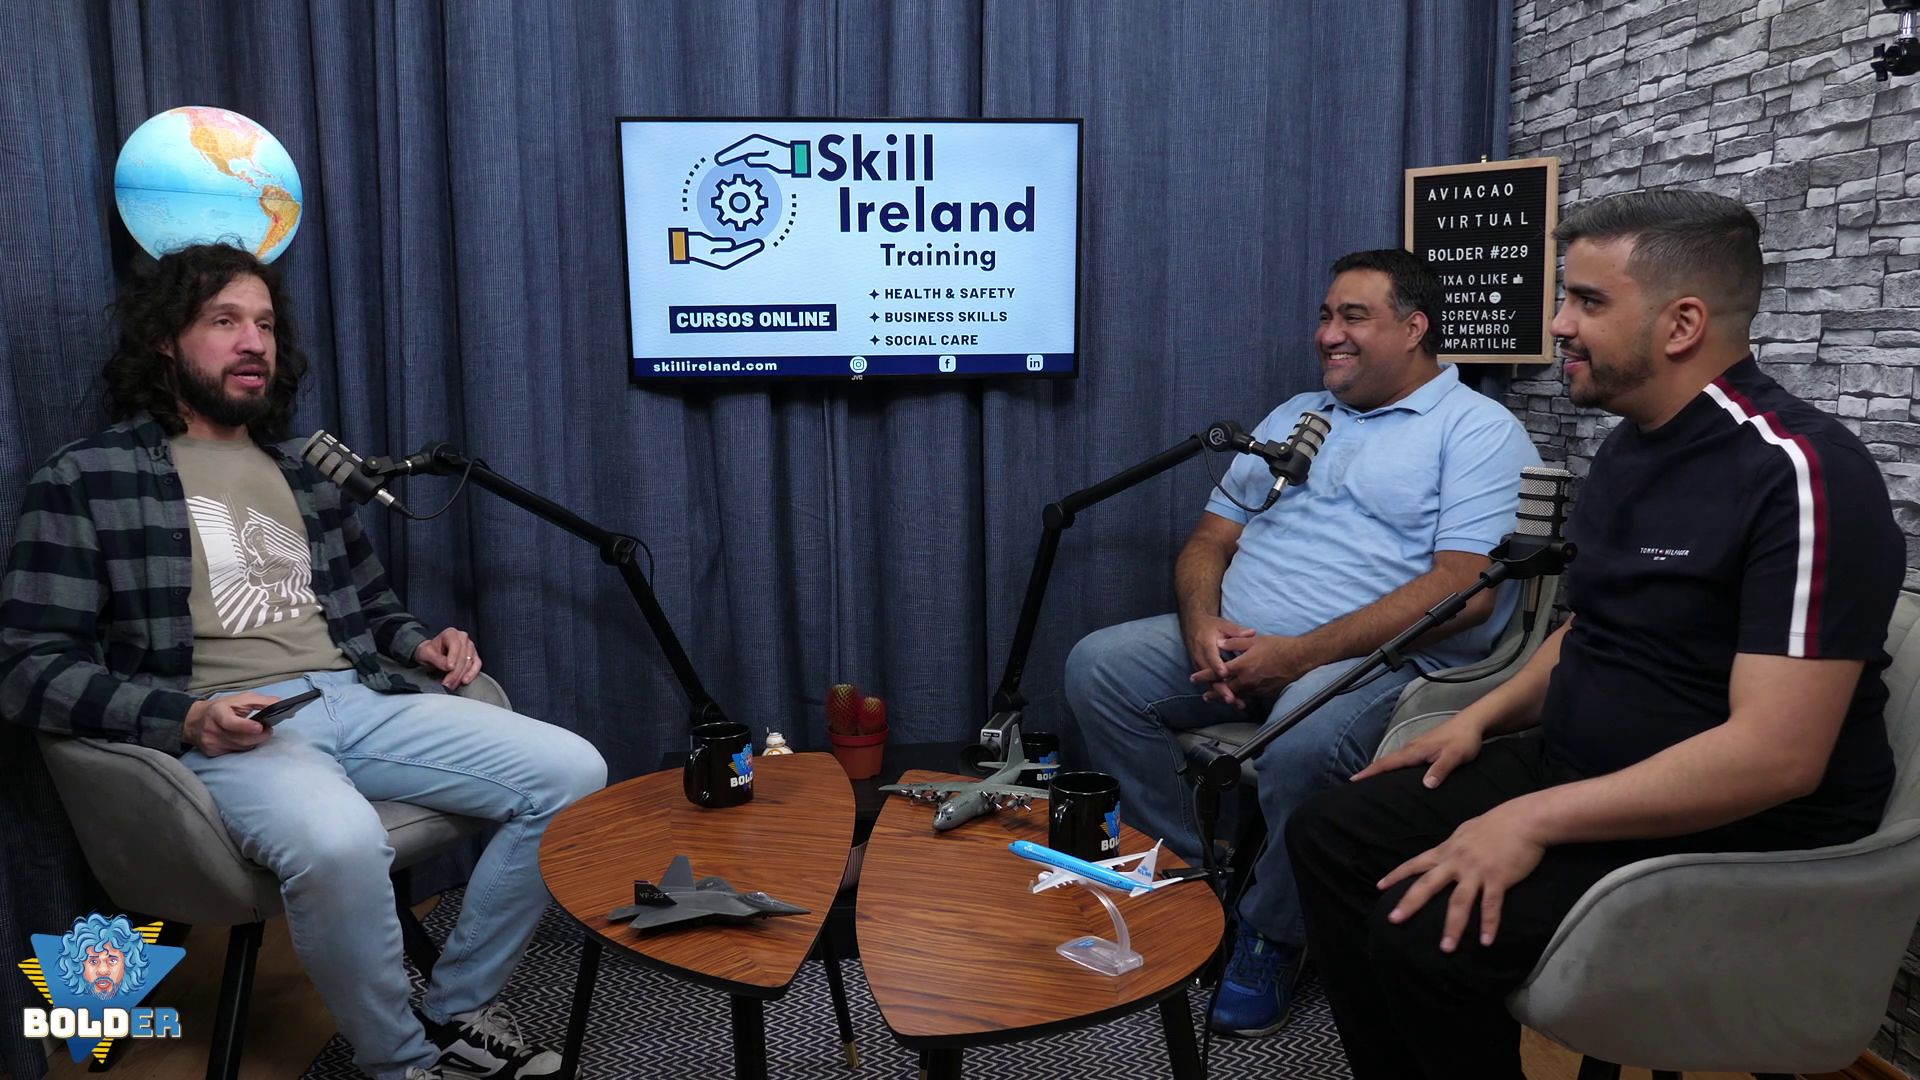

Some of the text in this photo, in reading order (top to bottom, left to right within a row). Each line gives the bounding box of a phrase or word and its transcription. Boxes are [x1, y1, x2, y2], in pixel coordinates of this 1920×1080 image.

[817, 133, 934, 182] Skill
[1427, 183, 1514, 201] AVIACAO
[839, 185, 1036, 233] Ireland
[1437, 211, 1529, 230] VIRTUAL
[879, 242, 997, 271] Training
[1427, 244, 1529, 262] BOLDER #229
[1439, 273, 1463, 286] IXA
[1480, 273, 1508, 285] LIKE
[884, 287, 1016, 300] HEALTH & SAFETY
[1444, 291, 1486, 304] MENTA
[676, 310, 831, 328] CURSOS ONLINE
[884, 311, 1008, 323] BUSINESS SKILLS
[1441, 309, 1507, 321] SCREVA-SE
[1459, 323, 1510, 335] MEMBRO
[884, 334, 979, 347] SOCIAL CARE
[1440, 337, 1517, 349] MPARTILHE
[653, 360, 778, 372] skillireland.com
